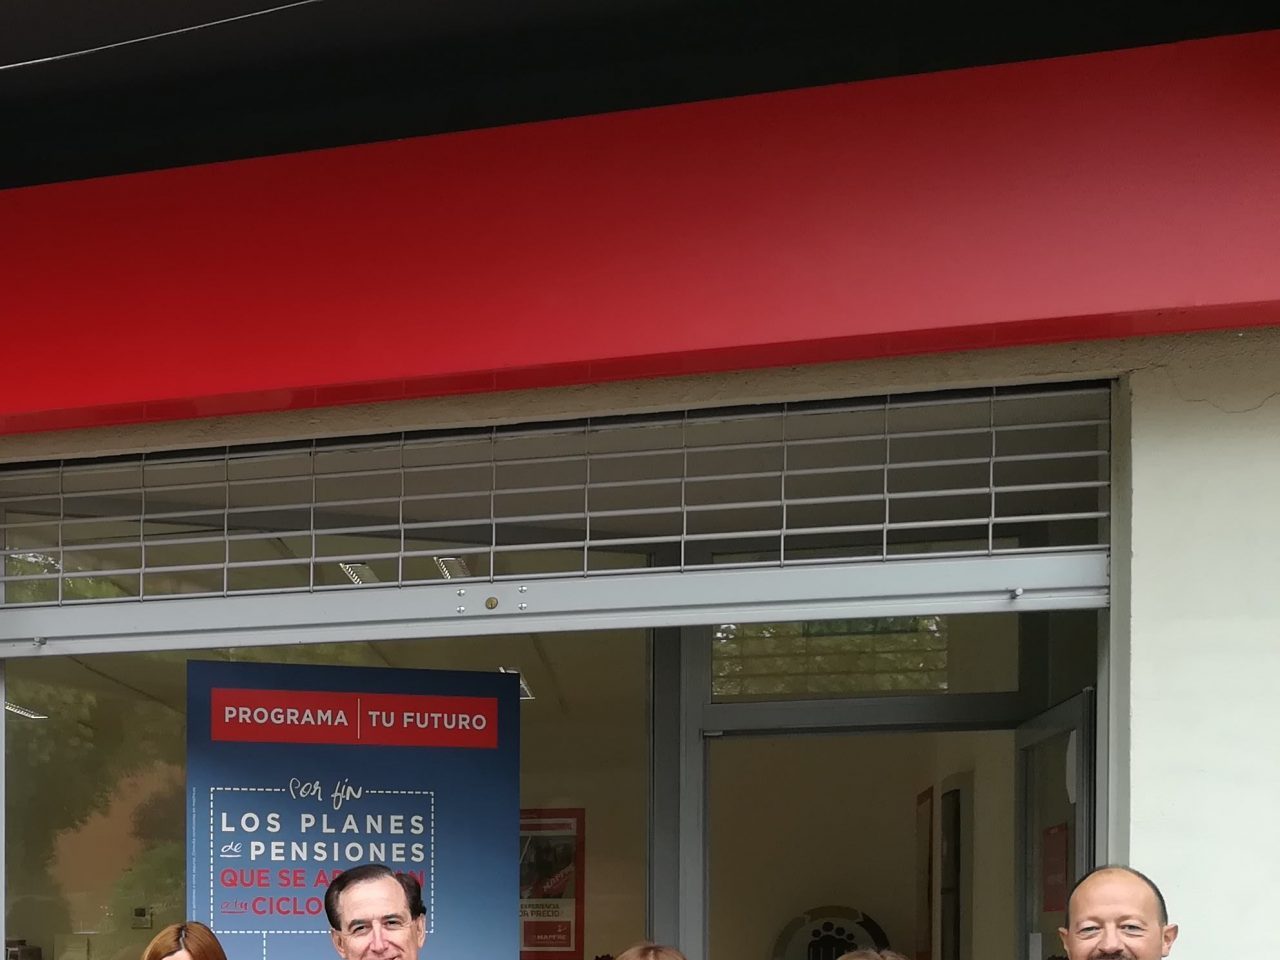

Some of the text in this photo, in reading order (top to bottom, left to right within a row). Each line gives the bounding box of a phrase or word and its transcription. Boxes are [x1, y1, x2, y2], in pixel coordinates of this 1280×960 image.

[224, 706, 487, 730] PROGRAMA TU FUTURO
[221, 812, 424, 835] LOS PLANES
[220, 841, 425, 862] de PENSIONES
[220, 868, 270, 888] QUE
[278, 868, 306, 888] SE
[252, 896, 323, 916] CICLO
